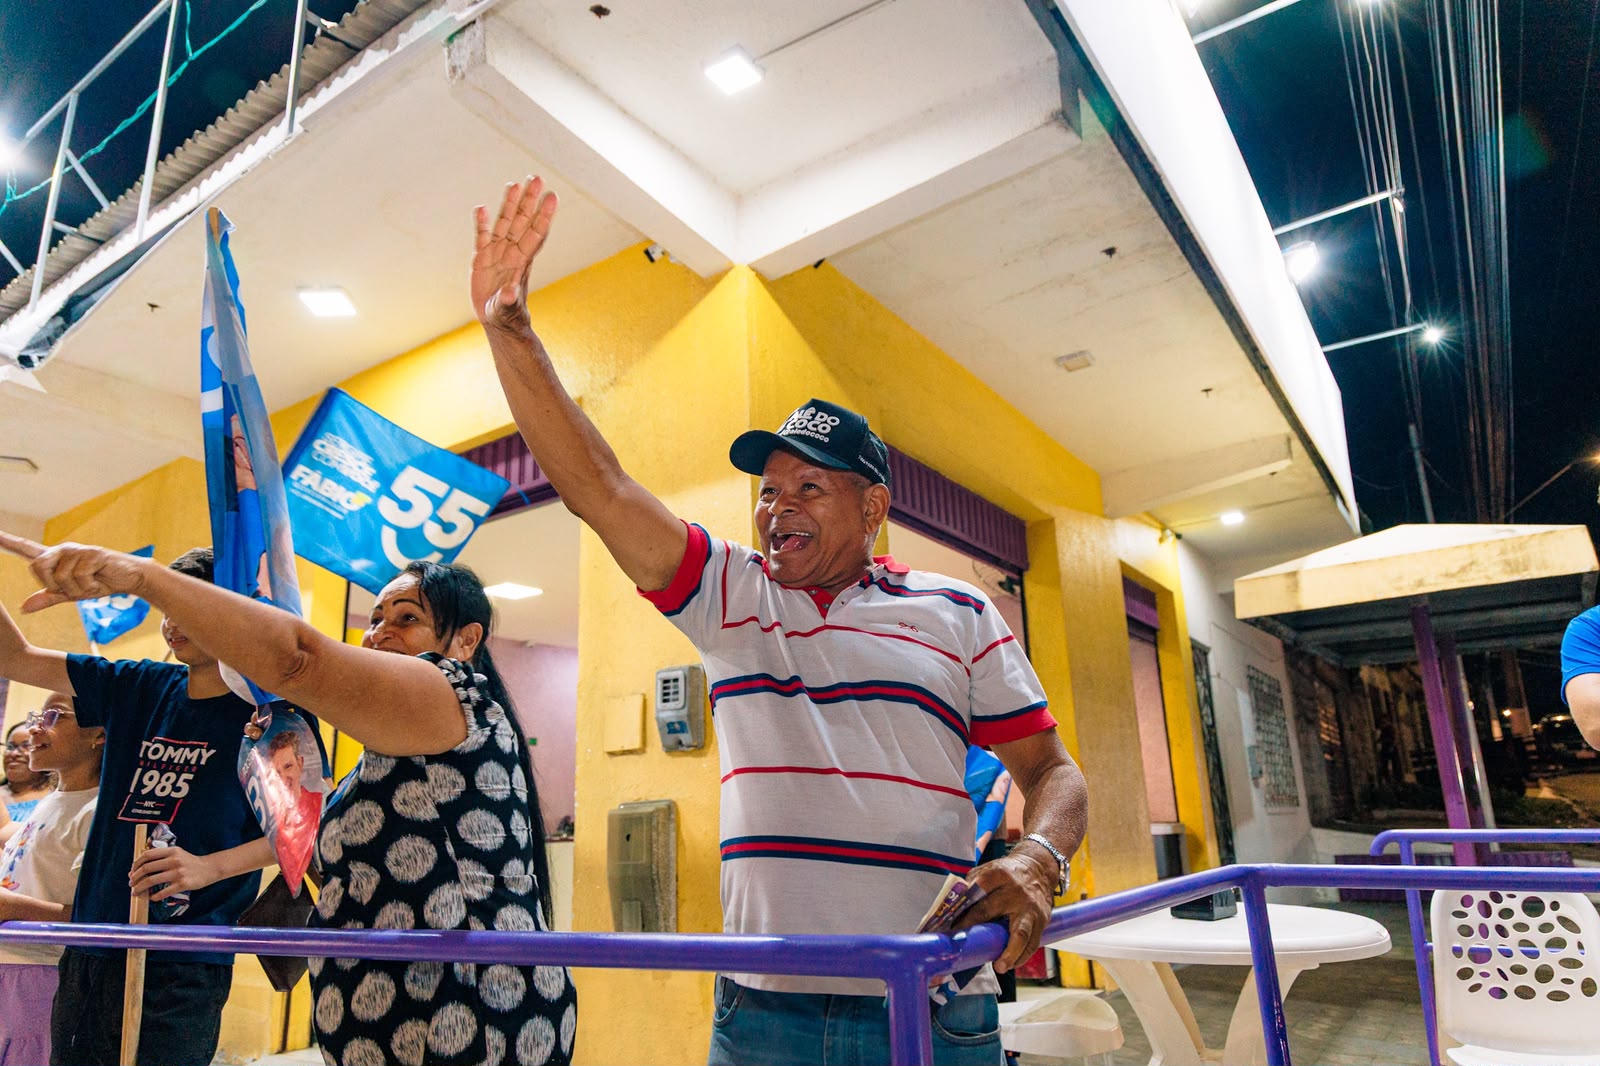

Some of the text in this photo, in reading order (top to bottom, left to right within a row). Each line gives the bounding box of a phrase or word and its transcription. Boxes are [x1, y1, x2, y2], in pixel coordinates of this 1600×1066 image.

[786, 418, 831, 434] COCO
[814, 411, 840, 426] DO
[377, 465, 491, 549] 55
[139, 740, 216, 766] TOMMY
[139, 760, 198, 773] HILFIGER
[129, 767, 195, 798] 1985
